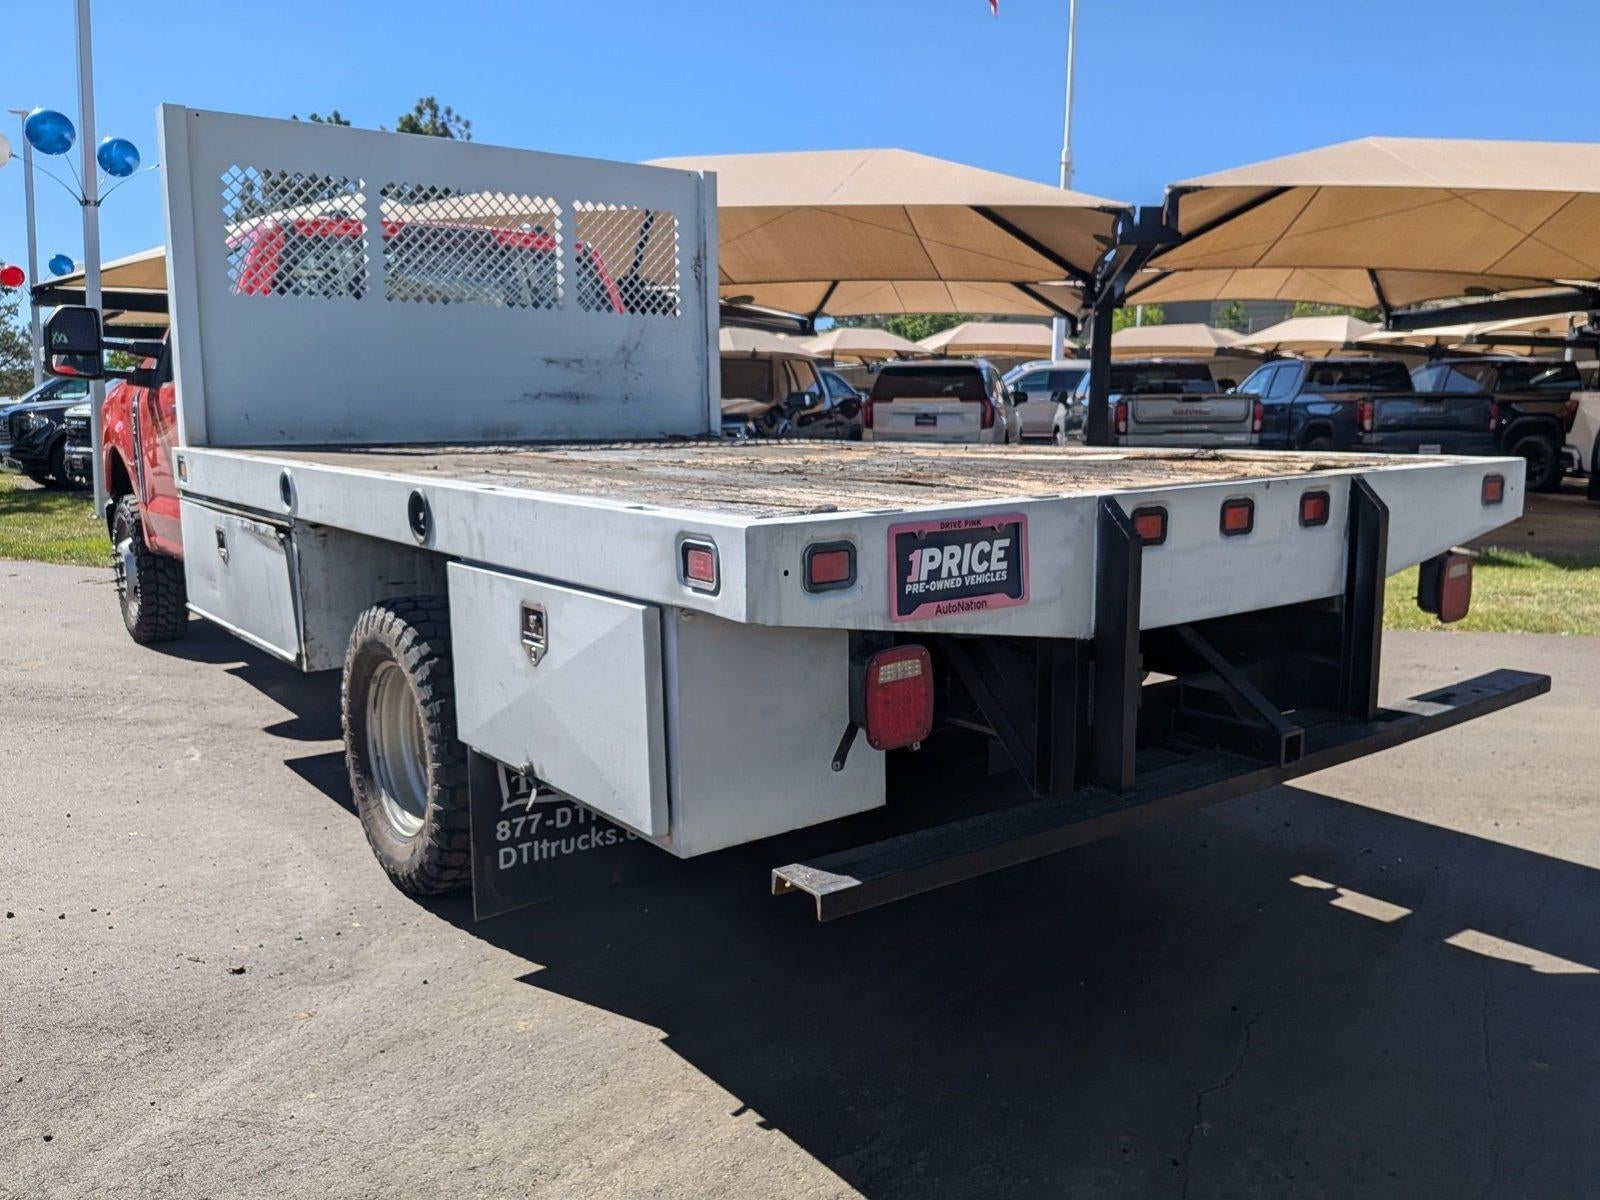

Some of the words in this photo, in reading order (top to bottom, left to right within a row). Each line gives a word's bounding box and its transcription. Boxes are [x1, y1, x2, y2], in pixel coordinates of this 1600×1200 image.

[939, 519, 963, 530] DRIVE
[964, 518, 982, 528] PINK
[906, 538, 1011, 583] 1PRICE
[905, 577, 962, 595] PRE-OWNED
[964, 570, 1008, 587] VEHICLES
[934, 599, 987, 616] AutoNation
